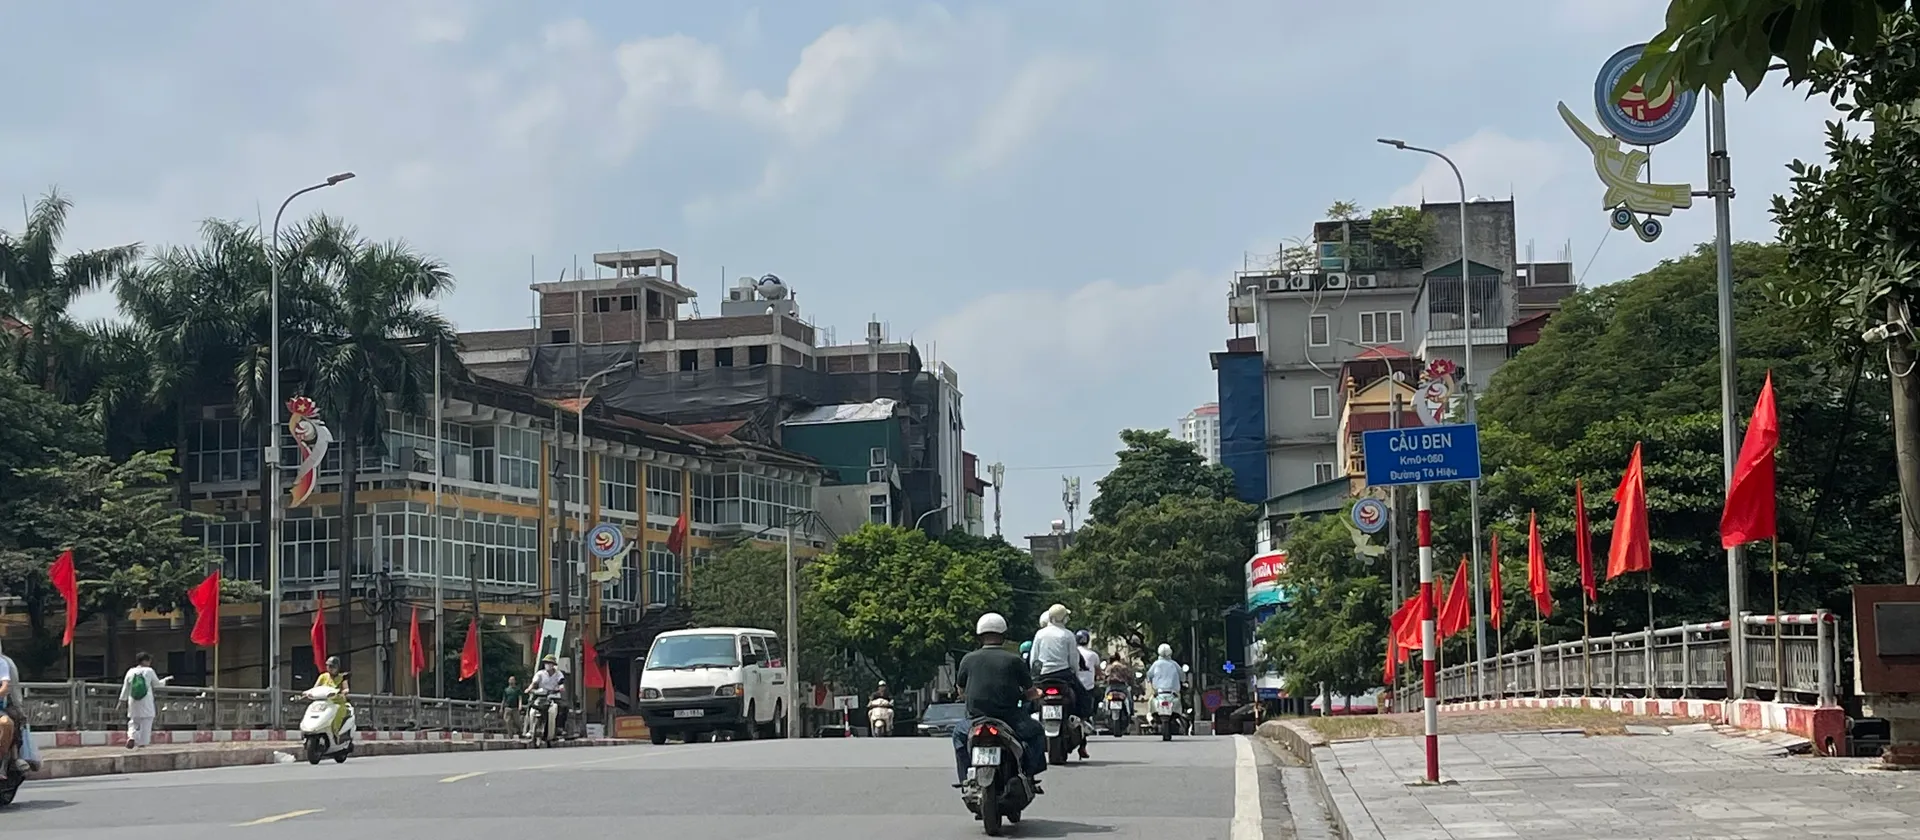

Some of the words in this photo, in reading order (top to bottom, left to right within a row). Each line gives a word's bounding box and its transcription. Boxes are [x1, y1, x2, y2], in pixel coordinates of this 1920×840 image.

[1389, 430, 1418, 452] CẦU
[1422, 433, 1452, 450] ĐEN
[1389, 470, 1421, 481] Đường
[1436, 467, 1458, 478] Hiệu
